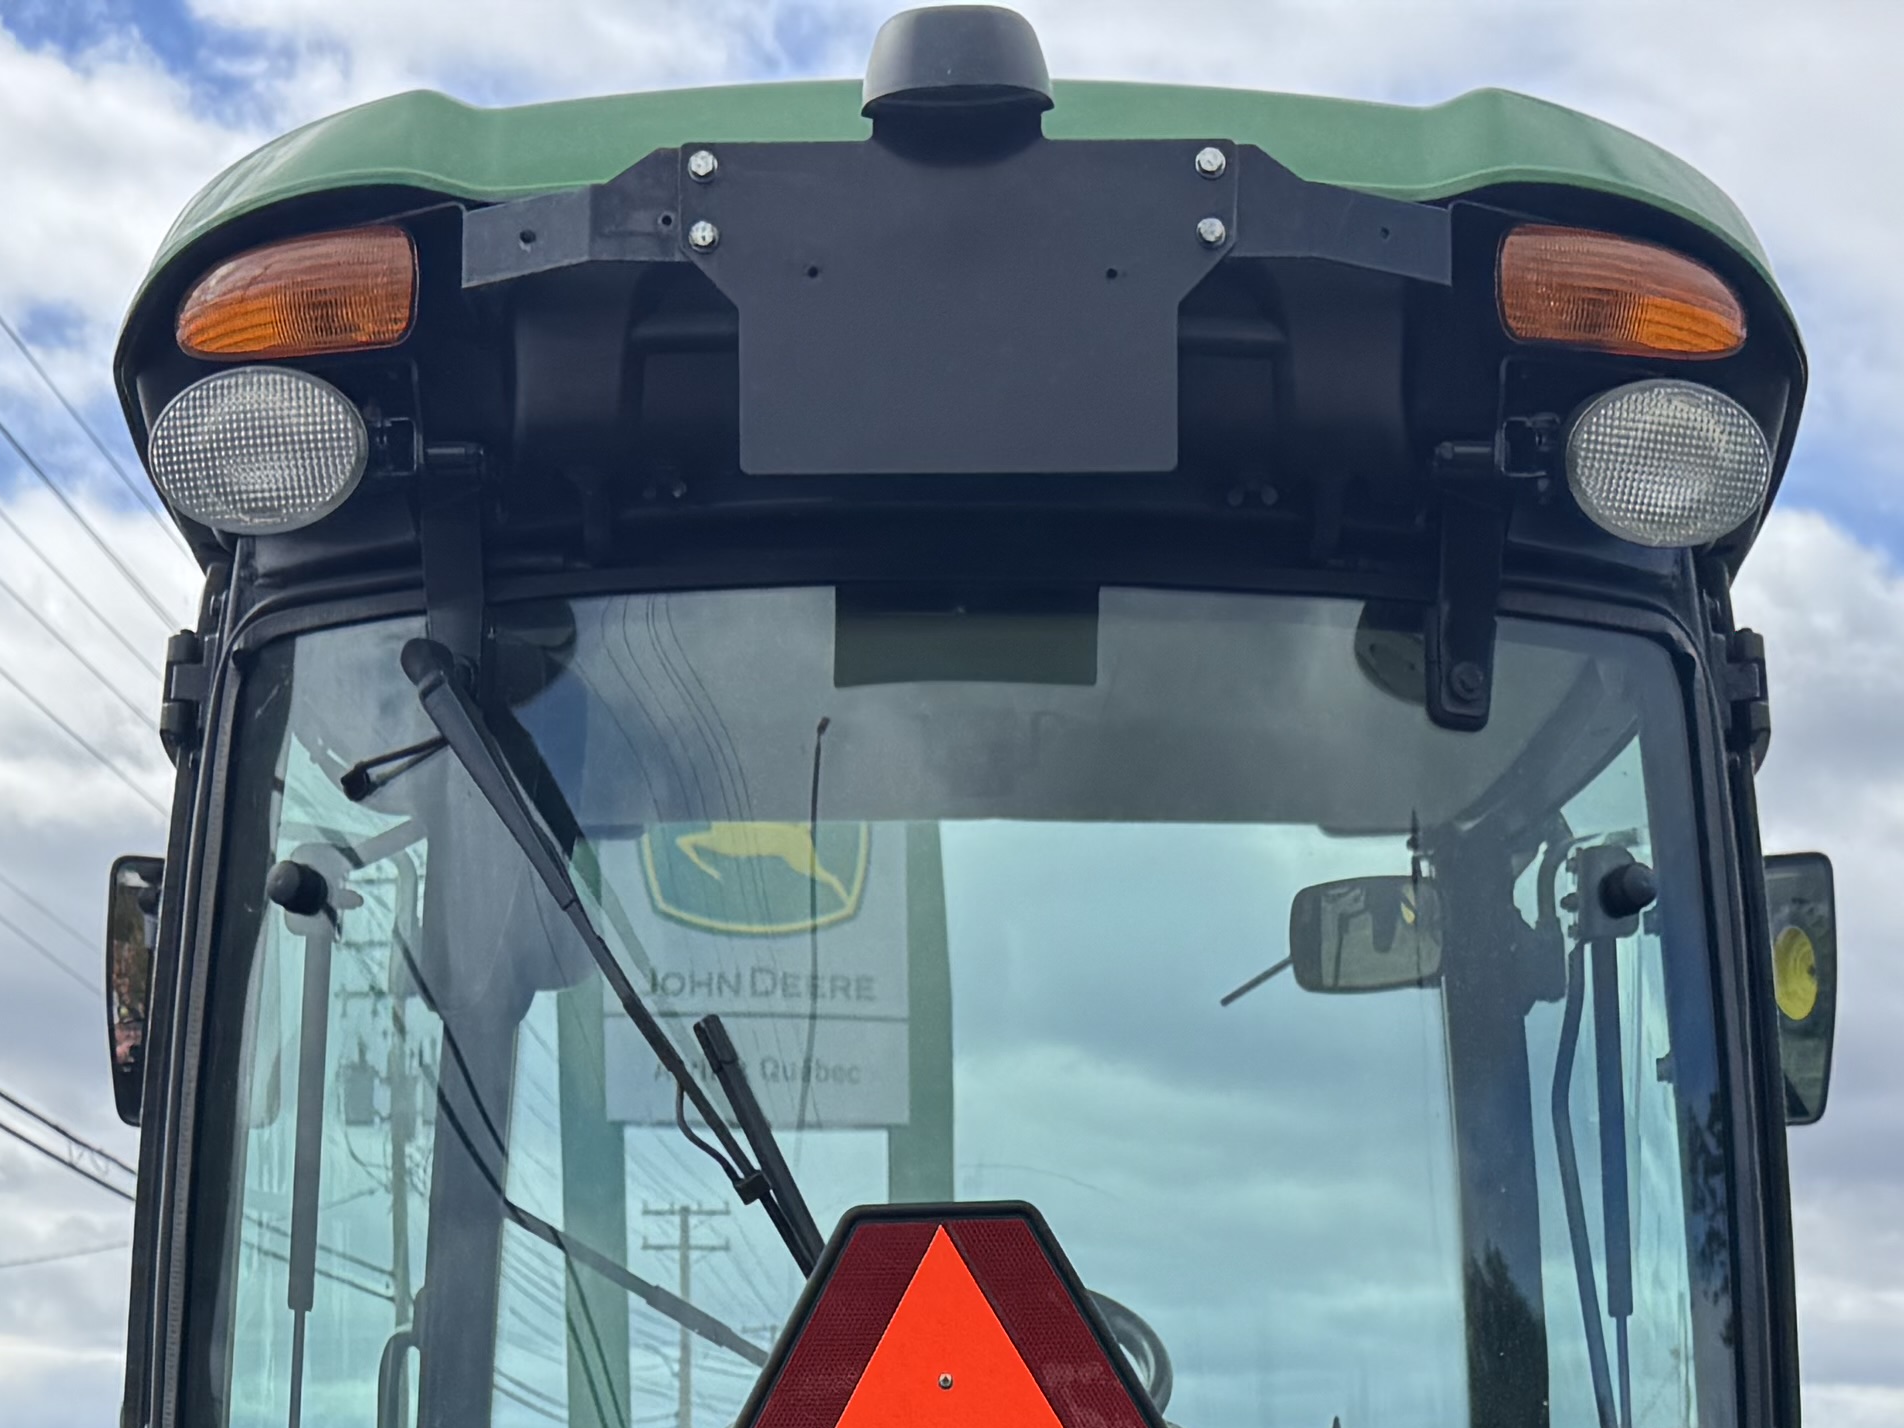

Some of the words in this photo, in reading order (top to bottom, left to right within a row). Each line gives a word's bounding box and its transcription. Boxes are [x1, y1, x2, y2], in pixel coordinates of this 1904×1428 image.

[644, 966, 743, 998] JOHN
[750, 966, 877, 1001] DEERE
[759, 1054, 863, 1085] Qubec
